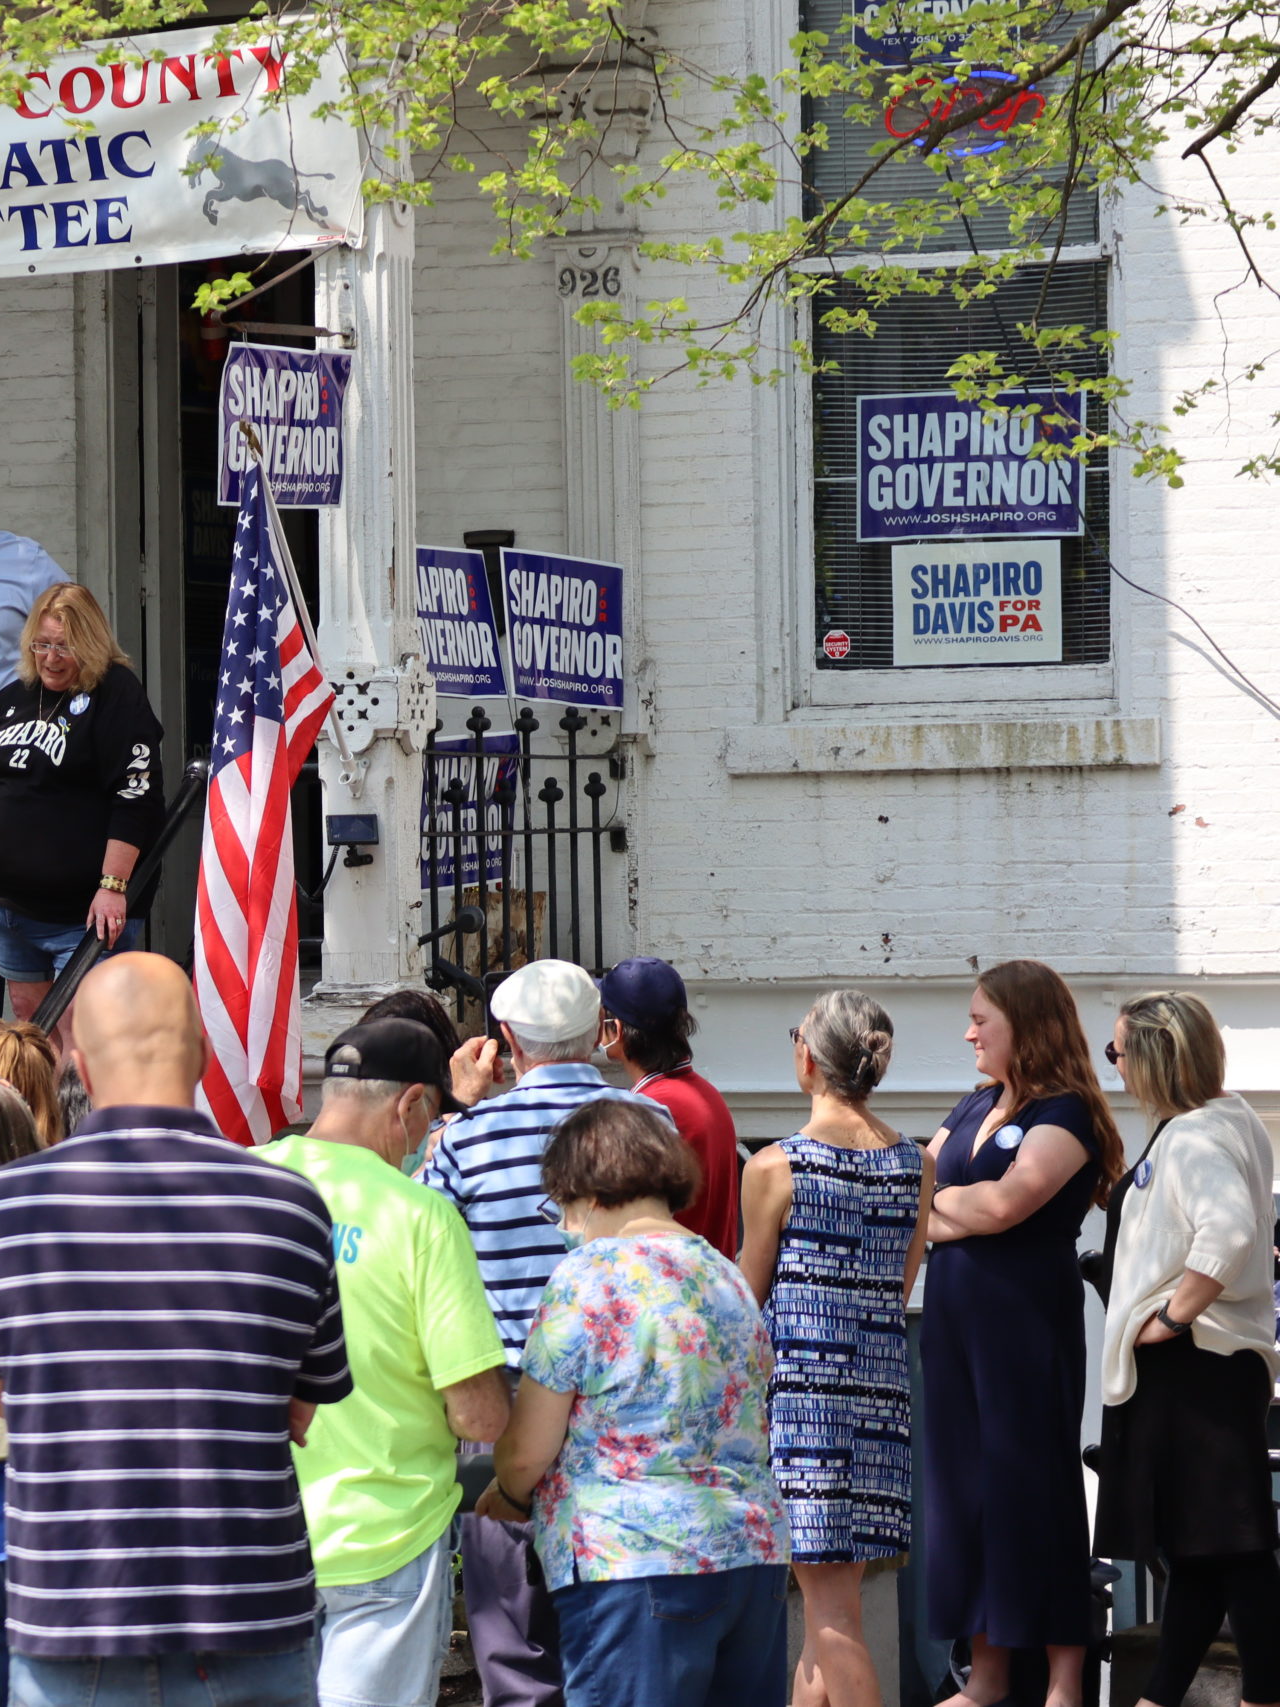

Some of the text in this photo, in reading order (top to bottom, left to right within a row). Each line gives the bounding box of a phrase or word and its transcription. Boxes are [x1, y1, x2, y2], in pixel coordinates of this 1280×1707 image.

[16, 47, 288, 120] COUNTY
[559, 266, 620, 297] 926
[228, 364, 320, 421] SHAPIRO
[868, 411, 1035, 461] SHAPIRO
[868, 460, 1073, 511] GOVERNOR
[884, 511, 1057, 526] WWW.JOSHSHAPIRO.ORG
[417, 566, 469, 616] APIRO
[509, 569, 597, 626] SHAPIRO
[911, 561, 1042, 599] SHAPIRO
[599, 588, 608, 622] FOR
[913, 600, 1041, 635] DAVIS FOR
[999, 614, 1043, 632] PA
[418, 617, 497, 668] OVERNOR
[513, 621, 623, 679] GOVERNOR
[913, 634, 1043, 645] WWW.SHAPIRODAVIS.ORG
[9, 748, 30, 769] 22
